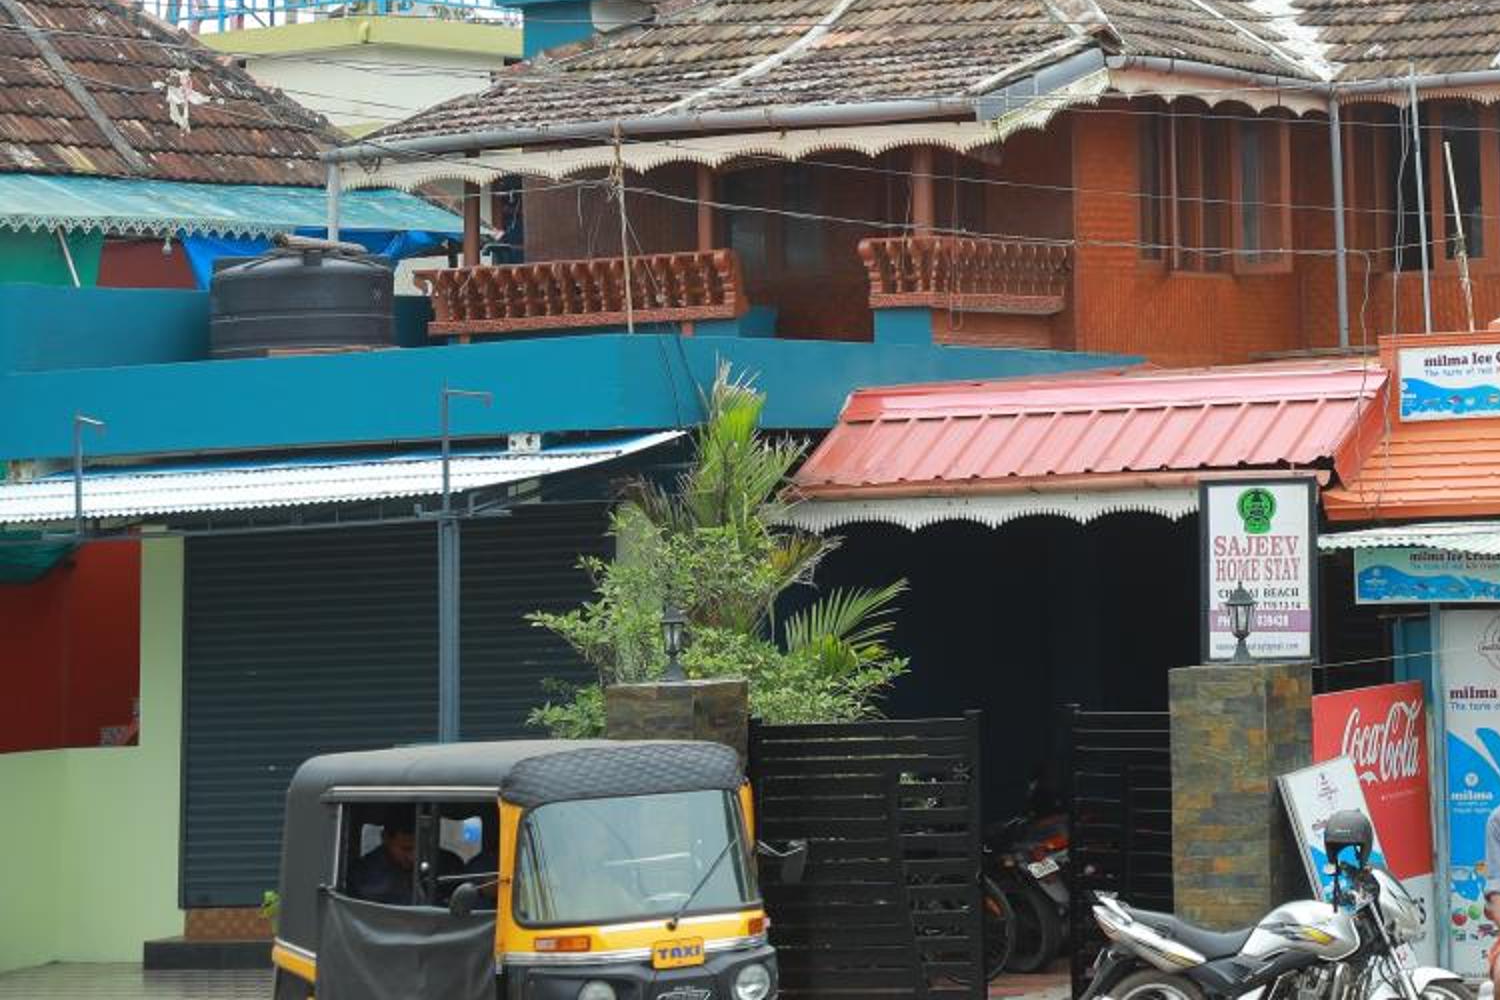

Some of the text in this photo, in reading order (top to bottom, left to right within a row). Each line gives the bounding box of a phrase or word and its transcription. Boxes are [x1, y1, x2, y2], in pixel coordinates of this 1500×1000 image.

[1424, 353, 1469, 367] milma
[1472, 352, 1493, 365] Ice
[1214, 536, 1299, 557] SAJEEV
[1215, 558, 1301, 581] HOME STAY
[1263, 587, 1299, 598] BEACH
[1450, 686, 1497, 700] milma
[1342, 698, 1423, 781] Coca-Cola
[658, 944, 701, 961] TAXI
